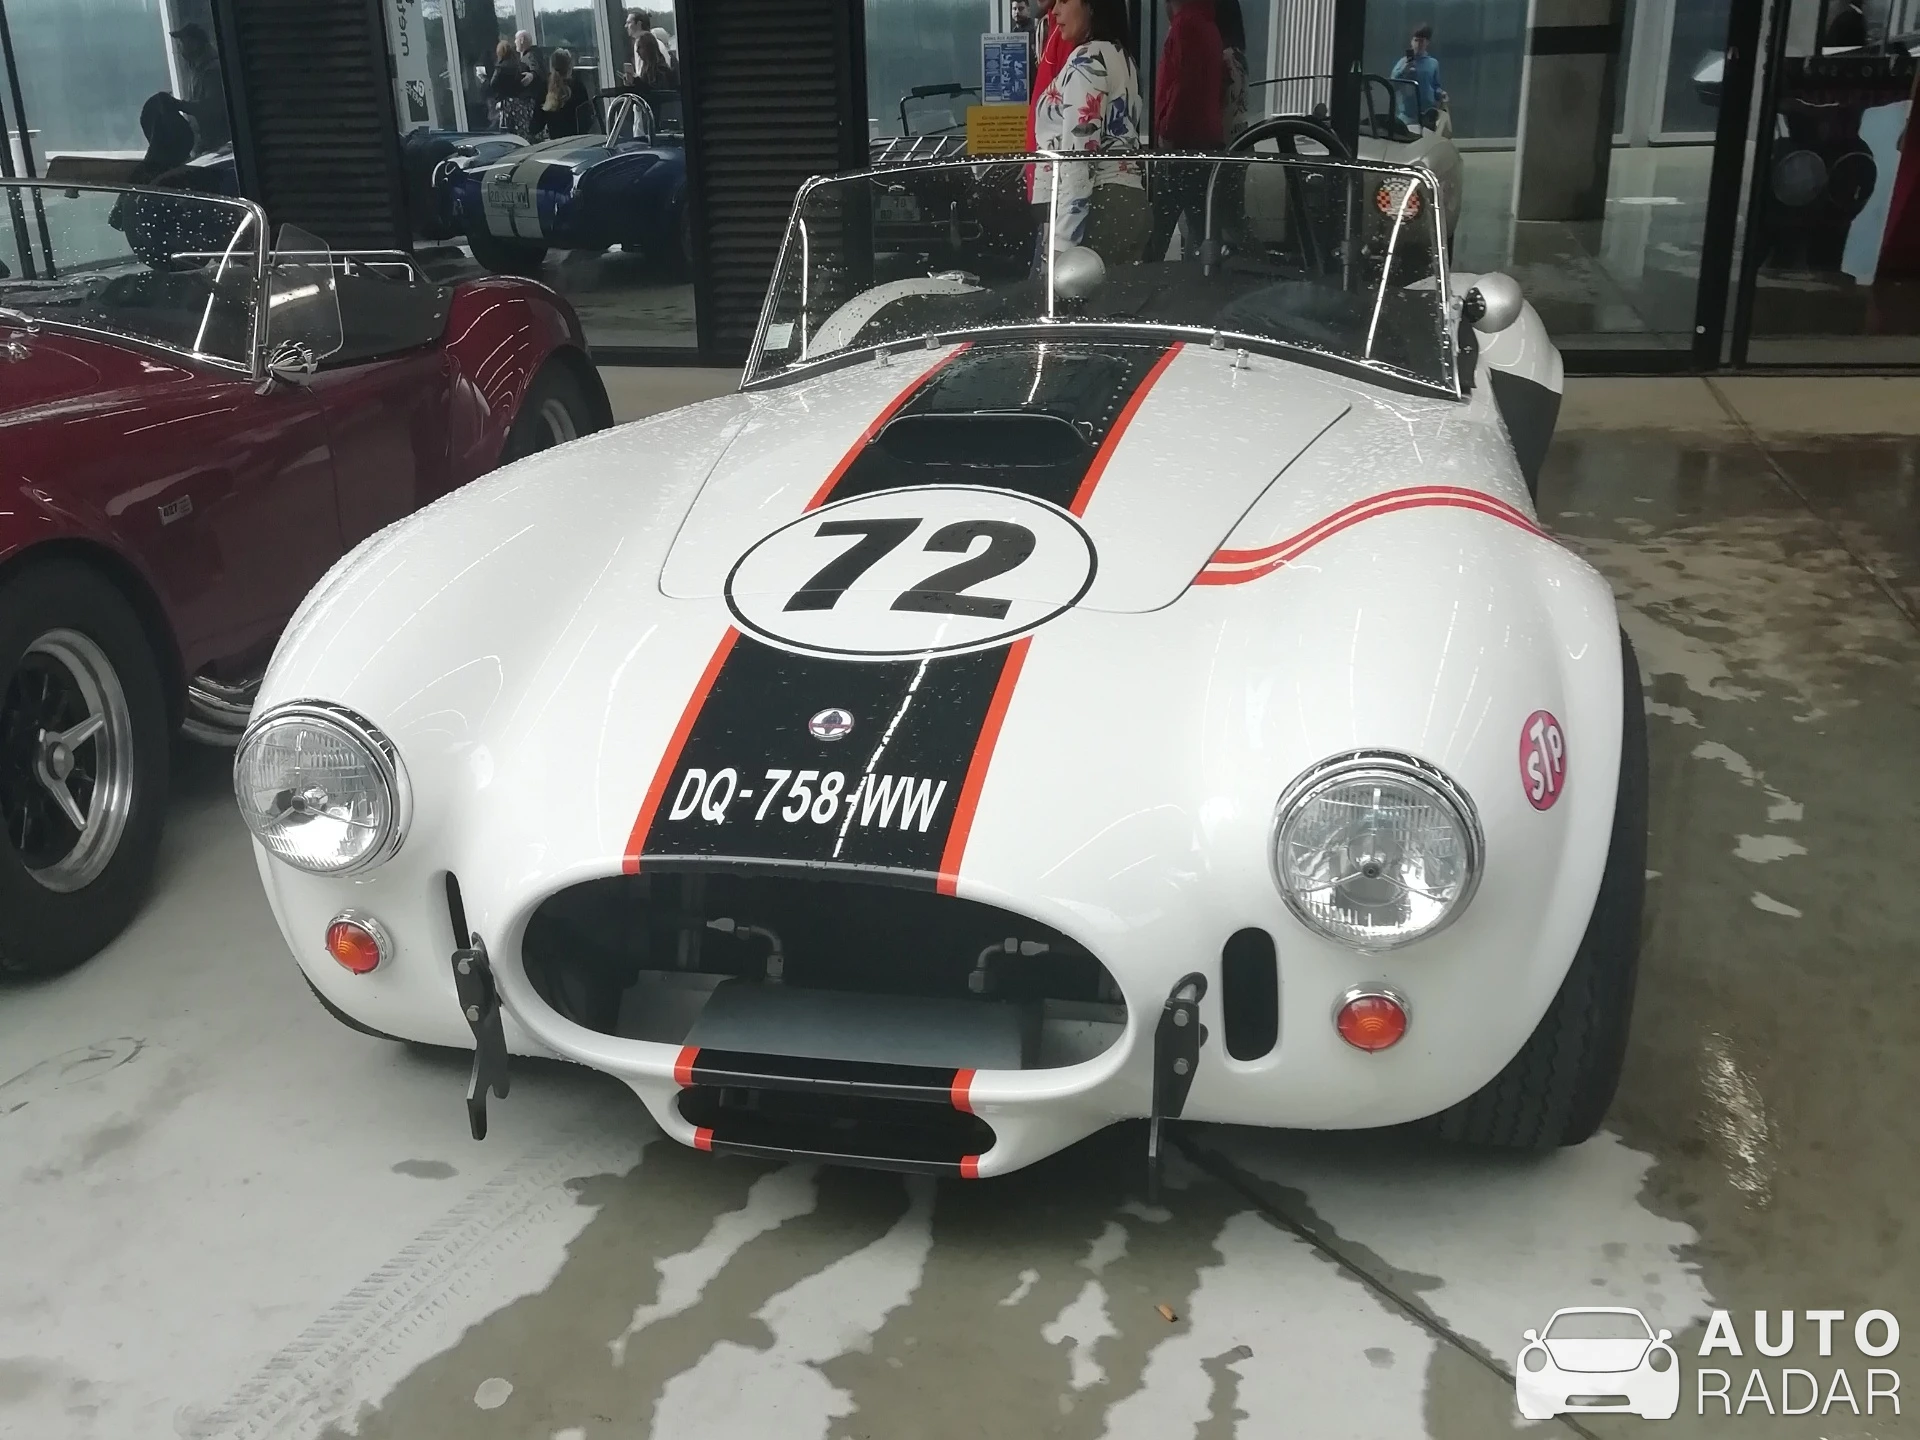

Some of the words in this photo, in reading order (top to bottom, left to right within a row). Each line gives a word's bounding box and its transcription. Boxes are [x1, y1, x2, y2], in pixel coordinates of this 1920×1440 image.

[781, 517, 1037, 620] 72
[668, 767, 948, 833] DQ-758-WW
[1527, 717, 1563, 801] STP
